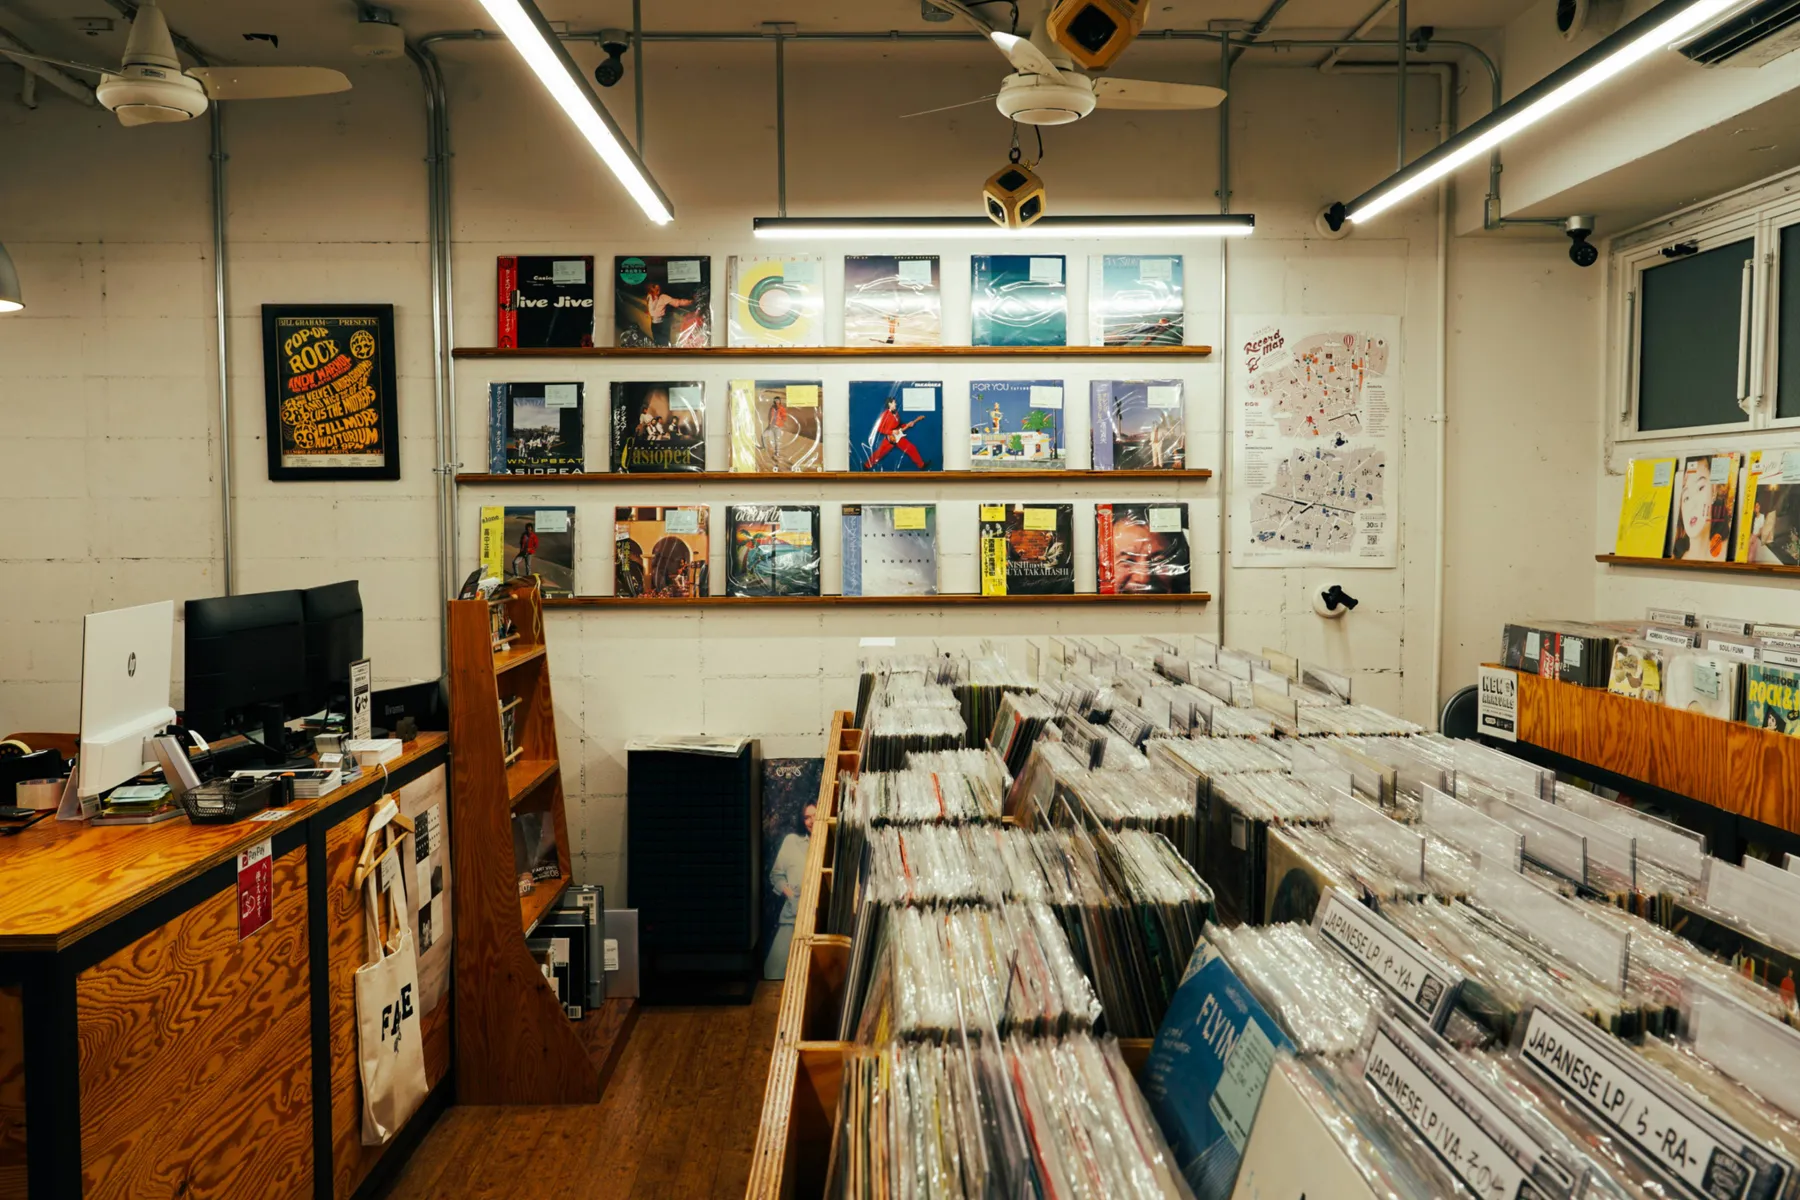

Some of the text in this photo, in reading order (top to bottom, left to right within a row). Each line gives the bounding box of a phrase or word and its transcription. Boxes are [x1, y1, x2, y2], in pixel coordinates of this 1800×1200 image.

[553, 296, 593, 308] Jive
[354, 343, 373, 357] 27
[1244, 329, 1280, 355] Record
[289, 339, 339, 374] ROCK
[288, 353, 351, 389] ANDY WARHOL
[306, 384, 333, 401] VELVET
[972, 383, 991, 391] FOR
[991, 382, 1009, 391] YOU
[327, 401, 344, 418] THE
[342, 385, 376, 414] MOTHERS
[317, 408, 379, 436] FILLMORE
[296, 432, 316, 447] 29
[315, 427, 379, 448] AUDITORIUM
[621, 437, 692, 470] Casiopea
[482, 515, 500, 524] alone
[1023, 567, 1069, 576] TAKAHASHI
[1482, 675, 1504, 695] NEW
[1763, 673, 1799, 688] HISTORY
[248, 846, 265, 861] PayPay
[1324, 910, 1368, 954] JAPANESE
[1383, 955, 1394, 975] や
[1394, 965, 1415, 992] -YA-
[1196, 992, 1240, 1066] FLYIN
[1368, 1055, 1421, 1120] JAPANESE
[1528, 1027, 1602, 1099] JAPANESE
[1636, 1107, 1648, 1137] ら
[1655, 1127, 1698, 1169] -RA-
